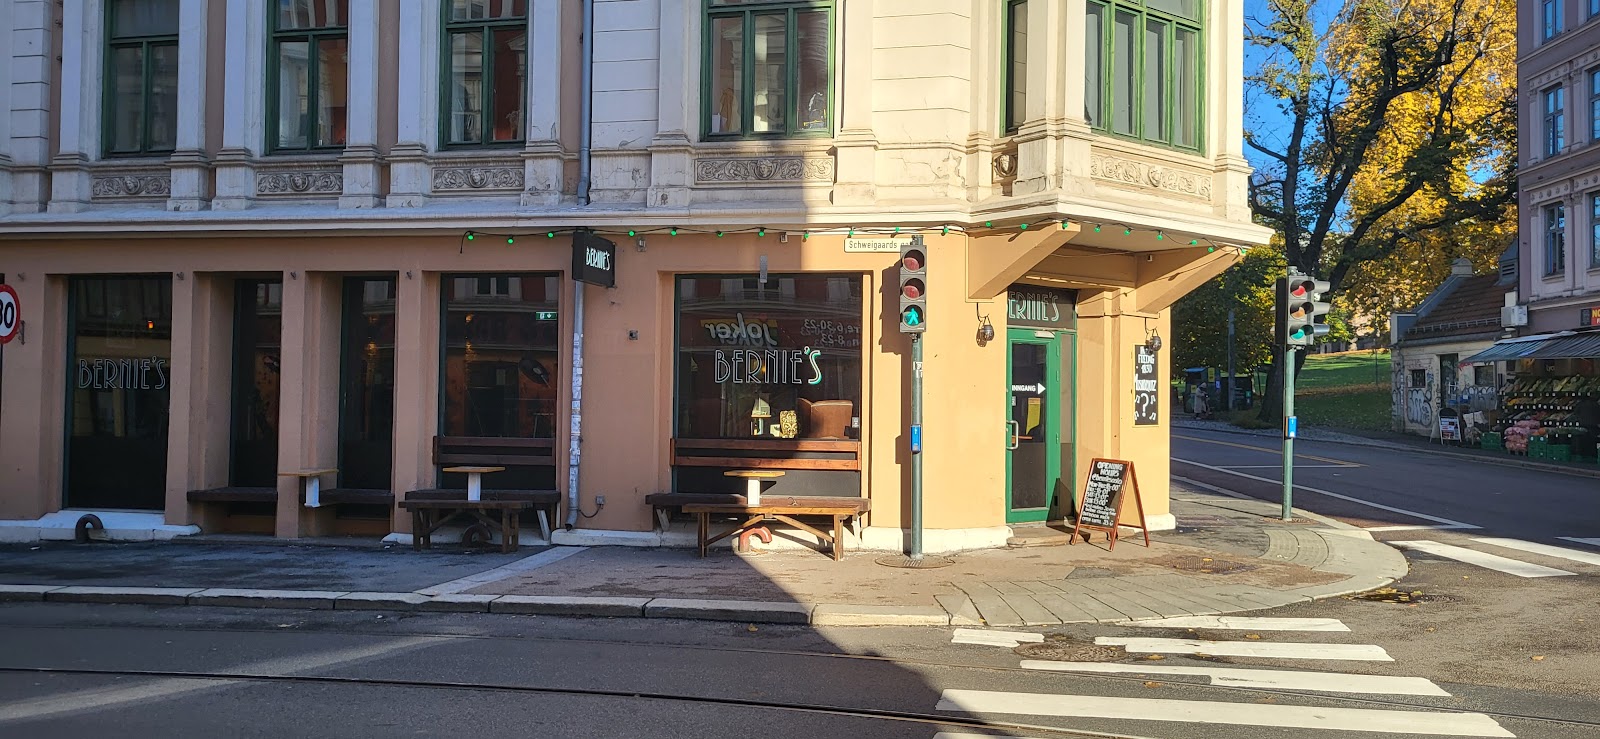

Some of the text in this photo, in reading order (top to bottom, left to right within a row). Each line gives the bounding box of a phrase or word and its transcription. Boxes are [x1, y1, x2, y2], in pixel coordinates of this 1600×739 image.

[586, 246, 610, 271] BERNIE'S
[849, 240, 897, 250] Schweigaards
[1008, 291, 1059, 322] ERNIE'S
[79, 356, 166, 389] BERNIE'S
[715, 346, 822, 385] BERNIE'S
[1097, 462, 1123, 470] OPENING
